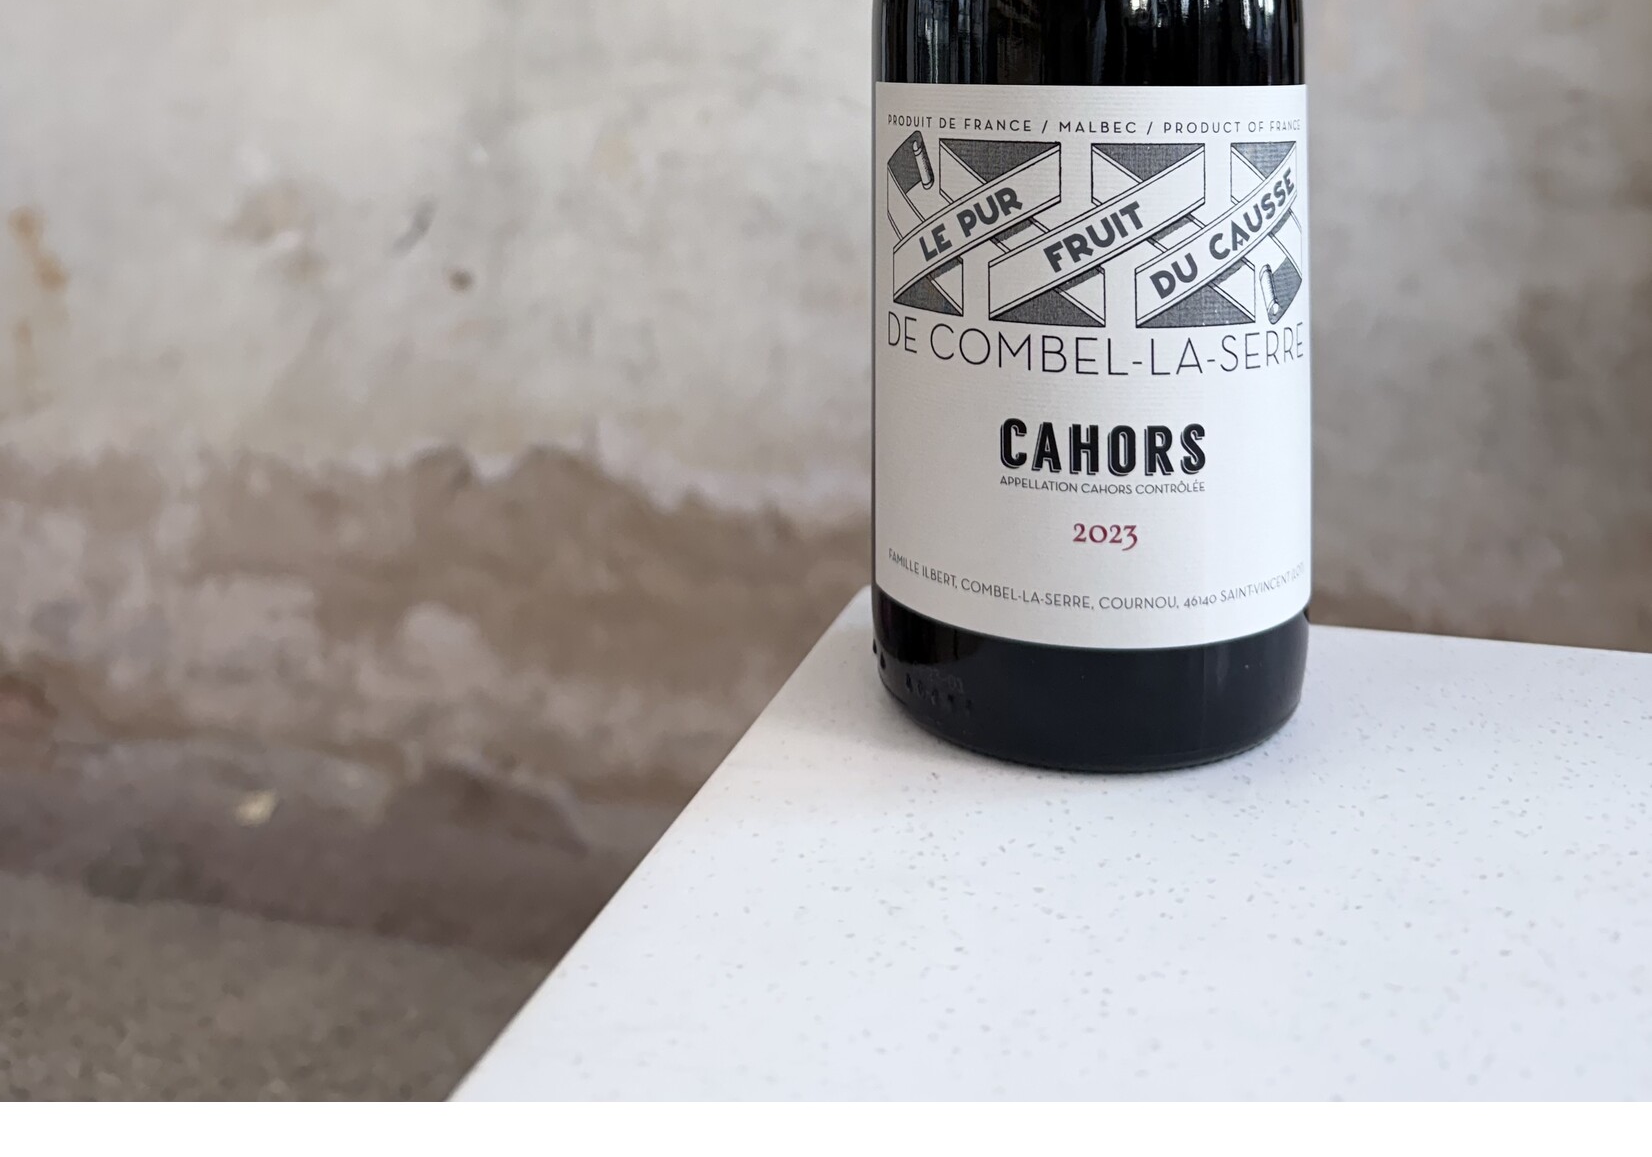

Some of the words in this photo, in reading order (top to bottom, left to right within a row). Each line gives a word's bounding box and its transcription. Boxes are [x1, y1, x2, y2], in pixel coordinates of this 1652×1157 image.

[888, 114, 932, 128] PRODUIT
[939, 117, 956, 129] DE
[964, 118, 1032, 132] FRANCE
[1059, 121, 1137, 133] MALBEC
[1163, 121, 1241, 134] PRODUCT
[1248, 120, 1264, 133] OF
[1269, 119, 1301, 132] FRANCE
[918, 223, 952, 262] LE
[956, 186, 1023, 238] PUR
[1043, 201, 1145, 273] FRUIT
[1149, 252, 1199, 300] DU
[1208, 166, 1296, 261] CAUSSE
[887, 311, 918, 355] DE
[929, 321, 1304, 376] COMBEL-LA-SERRE
[999, 417, 1206, 477] CAHORS
[1000, 475, 1078, 493] APPELLATION
[1081, 483, 1133, 495] CAHORS
[1135, 479, 1206, 495] CONTRÔLÉE
[1073, 522, 1139, 551] 2023
[888, 547, 920, 575] FAMILLE
[922, 565, 958, 590] ILBERT,
[961, 578, 1095, 611] COMBEL-LA-SERRE,
[1098, 597, 1180, 610] COURNOU,
[1183, 594, 1218, 609] 46140
[1220, 570, 1291, 603] SAINT-VINCENT
